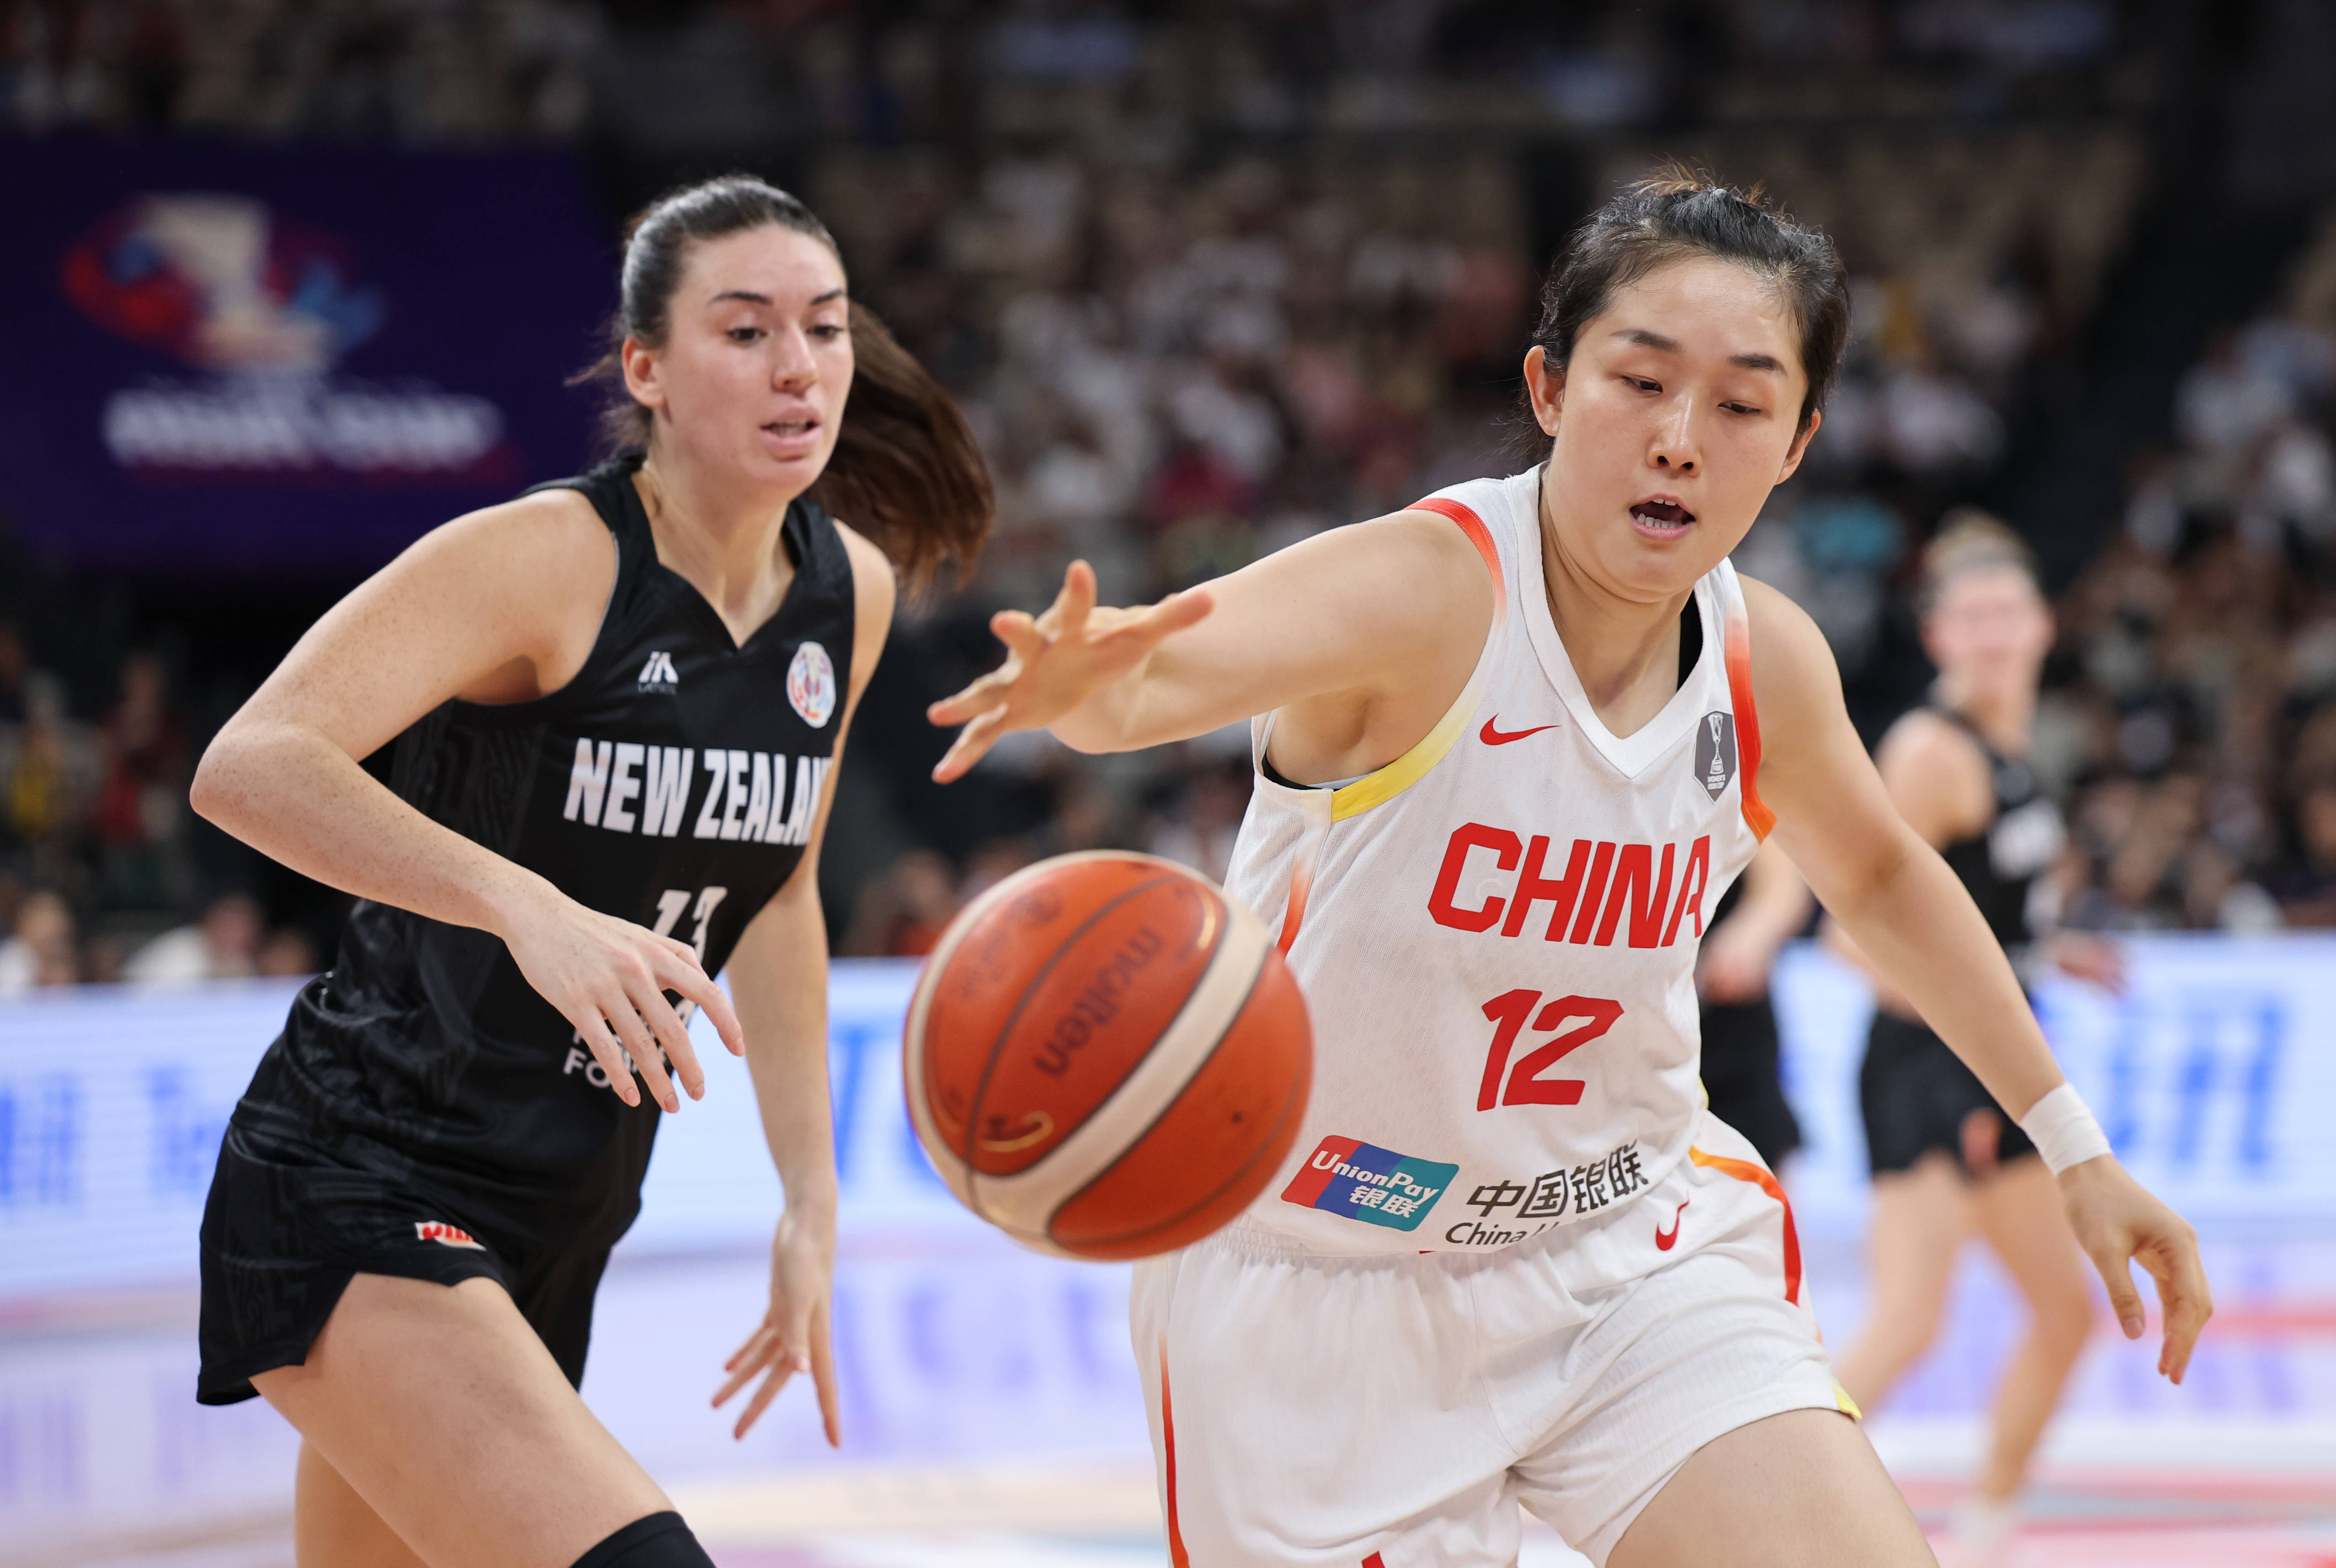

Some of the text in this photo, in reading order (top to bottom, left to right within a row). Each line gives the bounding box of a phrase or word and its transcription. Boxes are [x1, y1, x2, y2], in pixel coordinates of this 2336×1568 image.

[563, 737, 695, 838] NEW
[1427, 822, 1710, 949] CHINA
[1476, 989, 1625, 1112] 12
[1311, 1150, 1440, 1206] UnionPay
[1349, 1185, 1419, 1218] 银联
[1466, 1139, 1649, 1218] 中国银联
[1445, 1222, 1528, 1245] China
